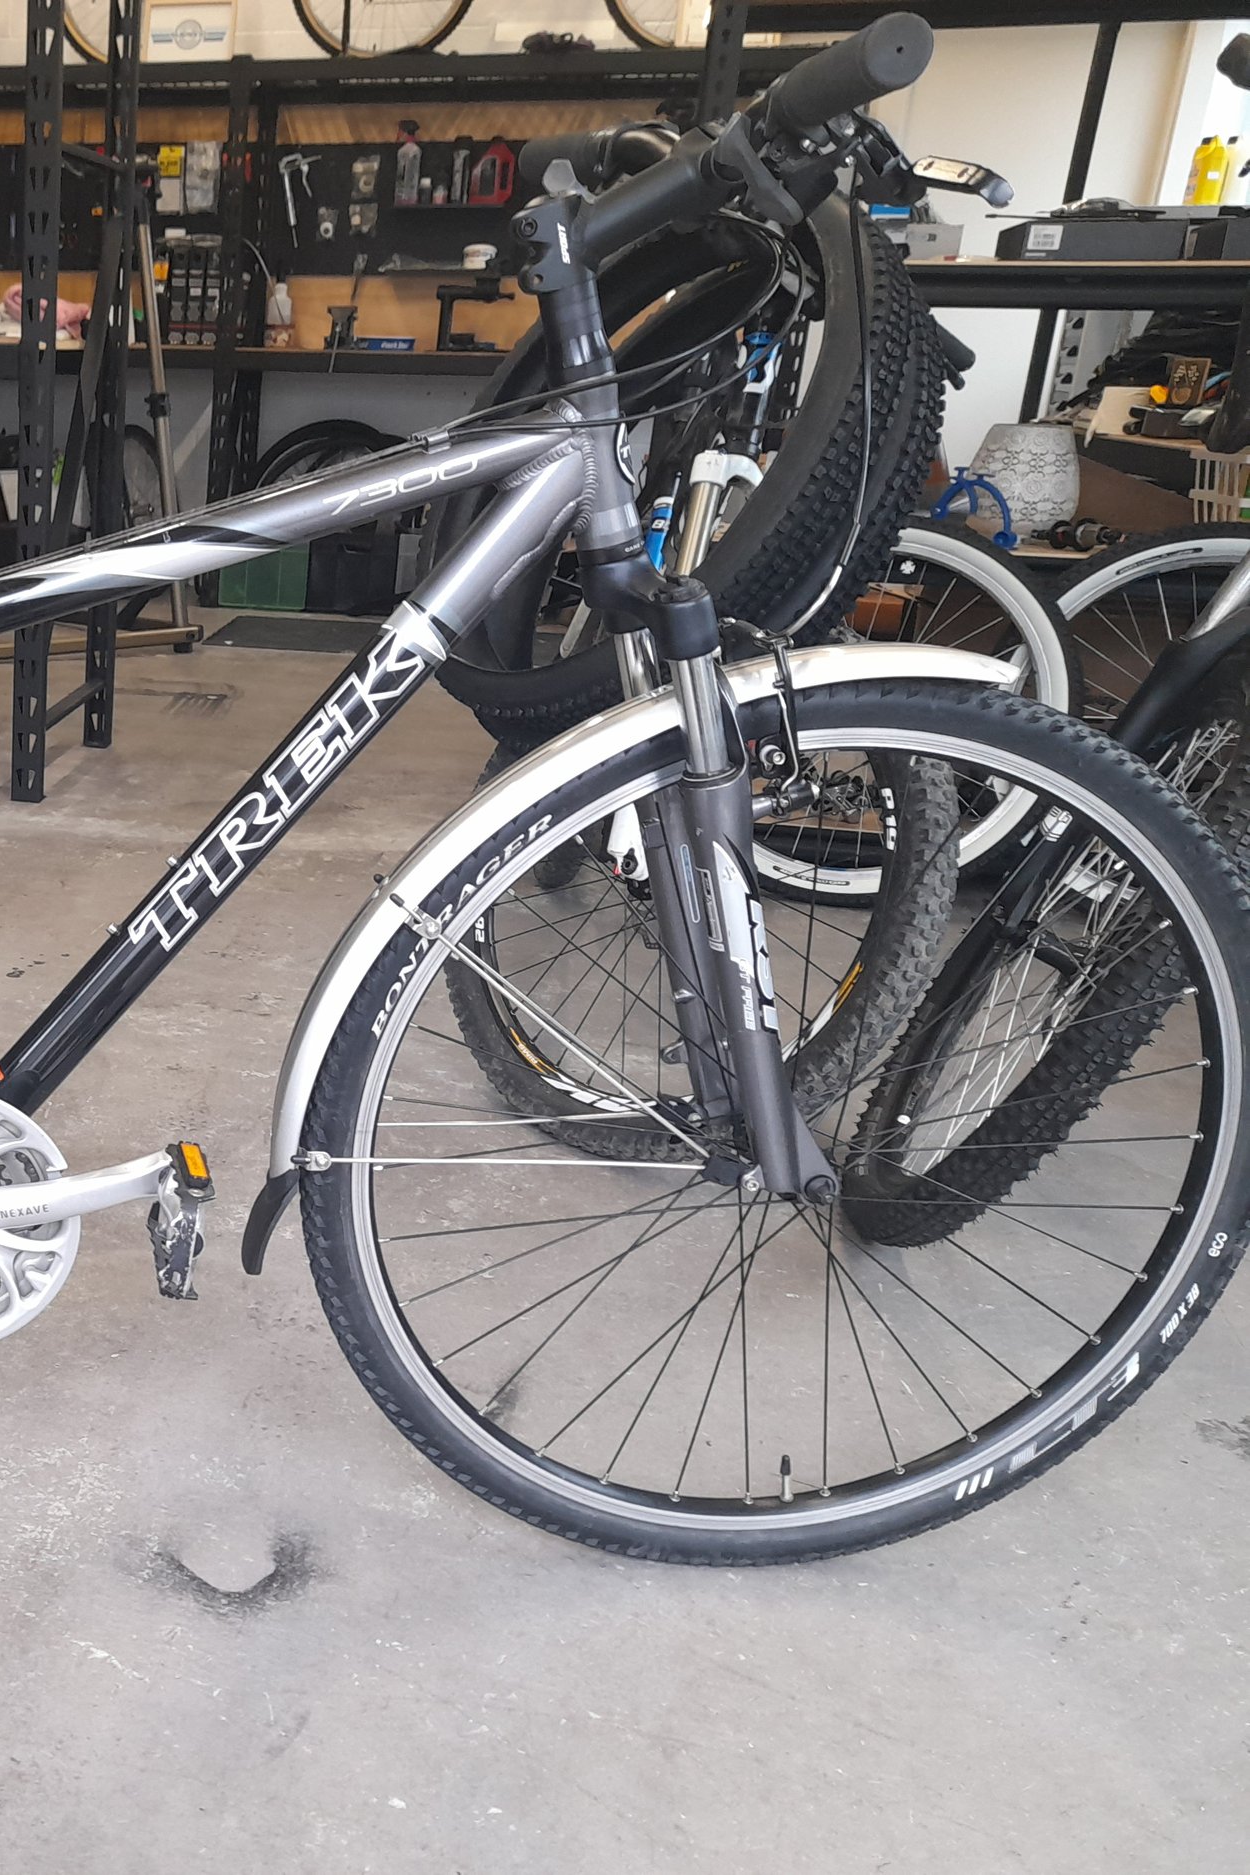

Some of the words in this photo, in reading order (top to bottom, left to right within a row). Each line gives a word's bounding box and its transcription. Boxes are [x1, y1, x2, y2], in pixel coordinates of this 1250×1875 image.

[556, 222, 571, 265] SPORT
[322, 454, 479, 516] 7300
[127, 628, 426, 953] TREK
[474, 916, 485, 943] 26
[0, 1203, 50, 1219] NEXAVE
[1159, 1312, 1181, 1345] 700
[1186, 1282, 1201, 1310] 38
